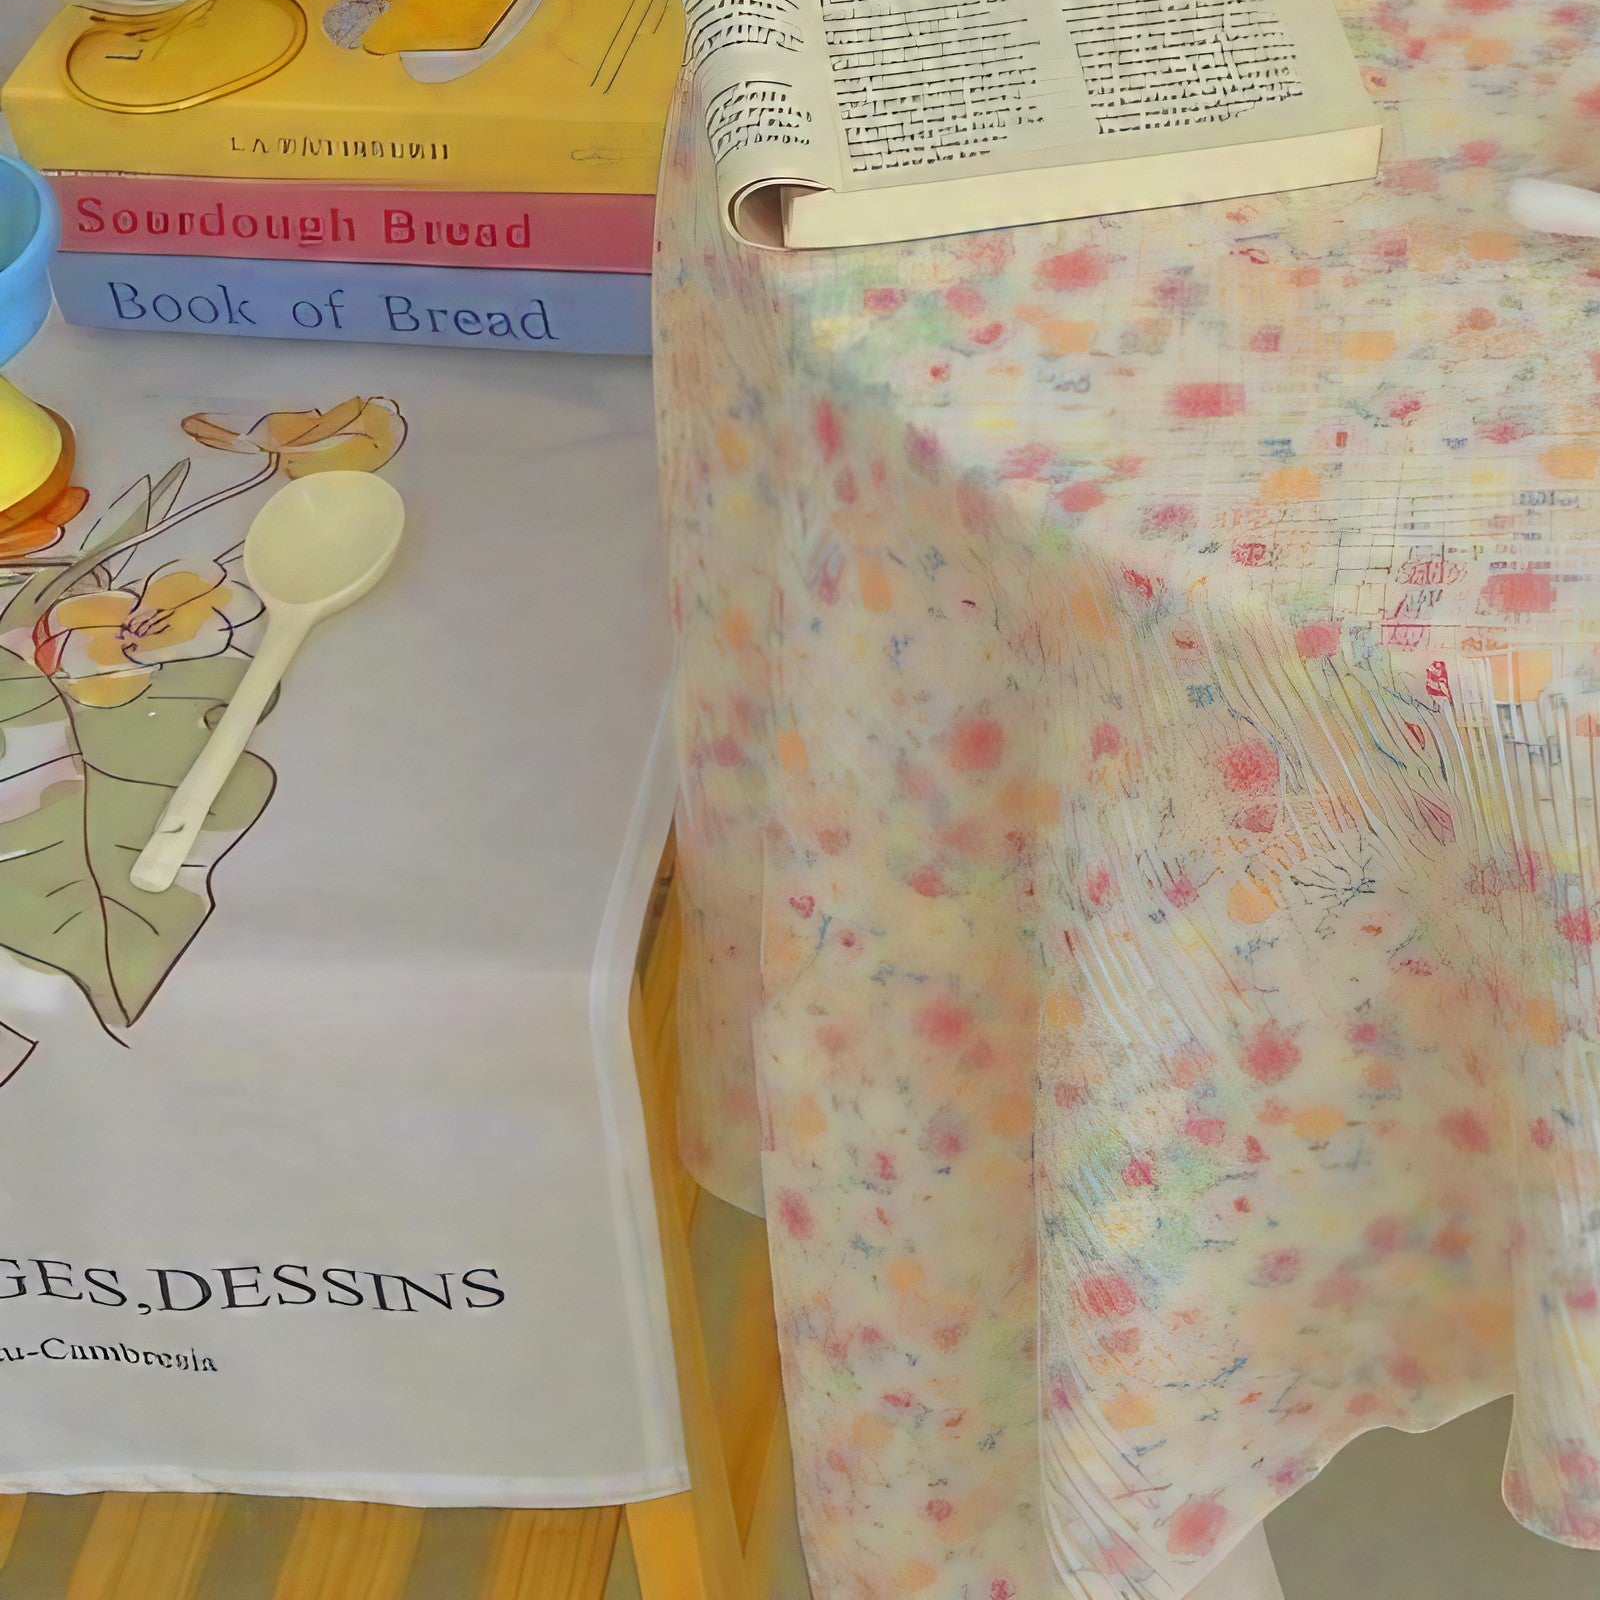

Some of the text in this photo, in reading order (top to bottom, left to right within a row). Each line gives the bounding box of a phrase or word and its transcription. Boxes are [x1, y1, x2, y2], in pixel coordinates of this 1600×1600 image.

[77, 197, 356, 248] Sourdough
[107, 280, 559, 341] Book of Bread
